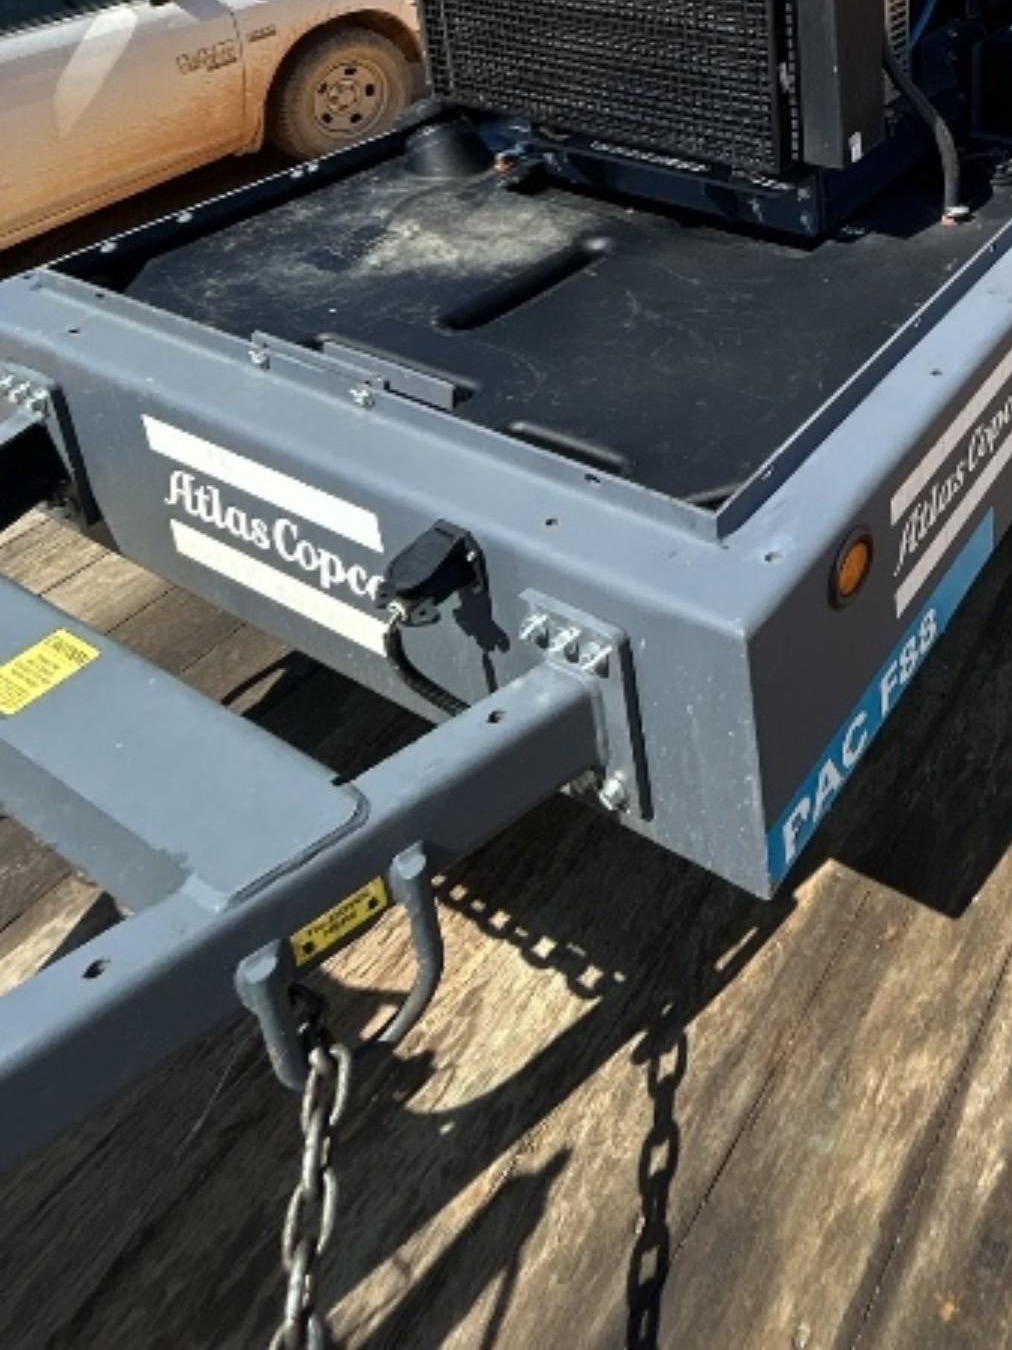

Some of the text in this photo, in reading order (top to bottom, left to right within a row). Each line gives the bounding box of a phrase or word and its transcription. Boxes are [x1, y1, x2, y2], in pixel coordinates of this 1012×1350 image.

[164, 469, 272, 550] Atlas
[893, 458, 965, 578] Atlas
[782, 709, 868, 865] PAC
